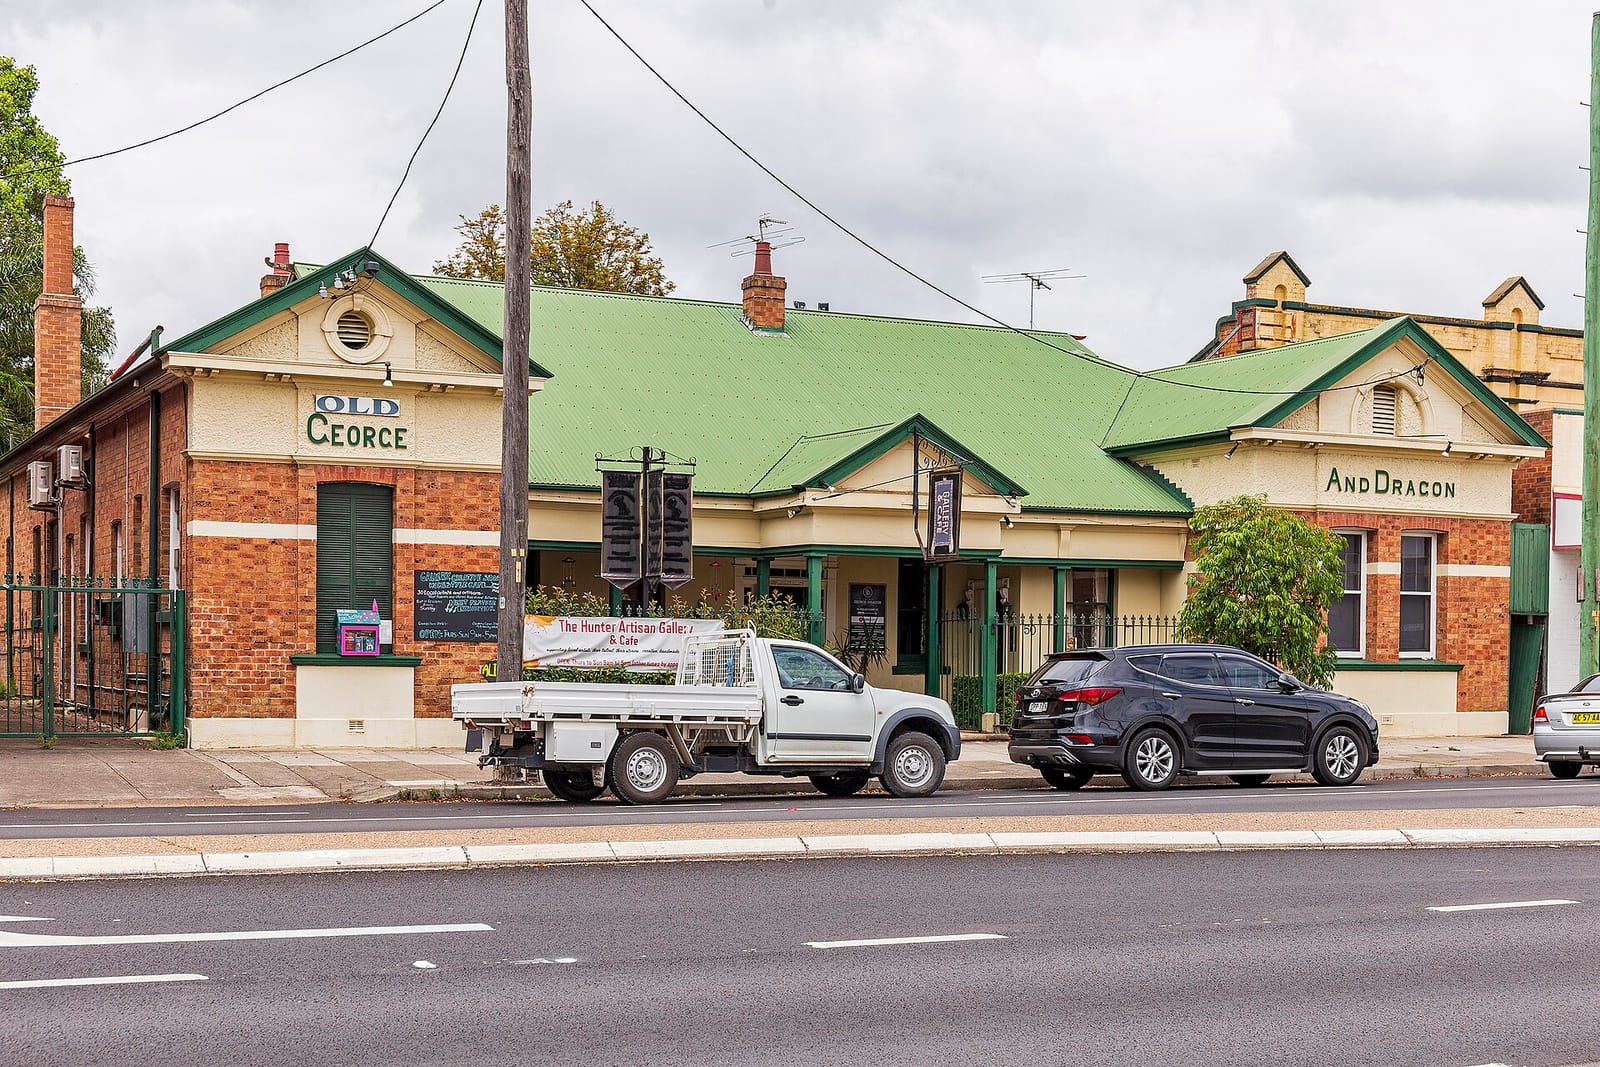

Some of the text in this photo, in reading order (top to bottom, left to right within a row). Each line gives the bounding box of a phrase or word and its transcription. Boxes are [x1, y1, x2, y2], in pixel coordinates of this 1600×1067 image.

[317, 396, 399, 415] OLD
[559, 620, 577, 632] The
[581, 620, 616, 633] Hunter
[619, 620, 655, 634] Artisan
[610, 635, 638, 646] & Cafe
